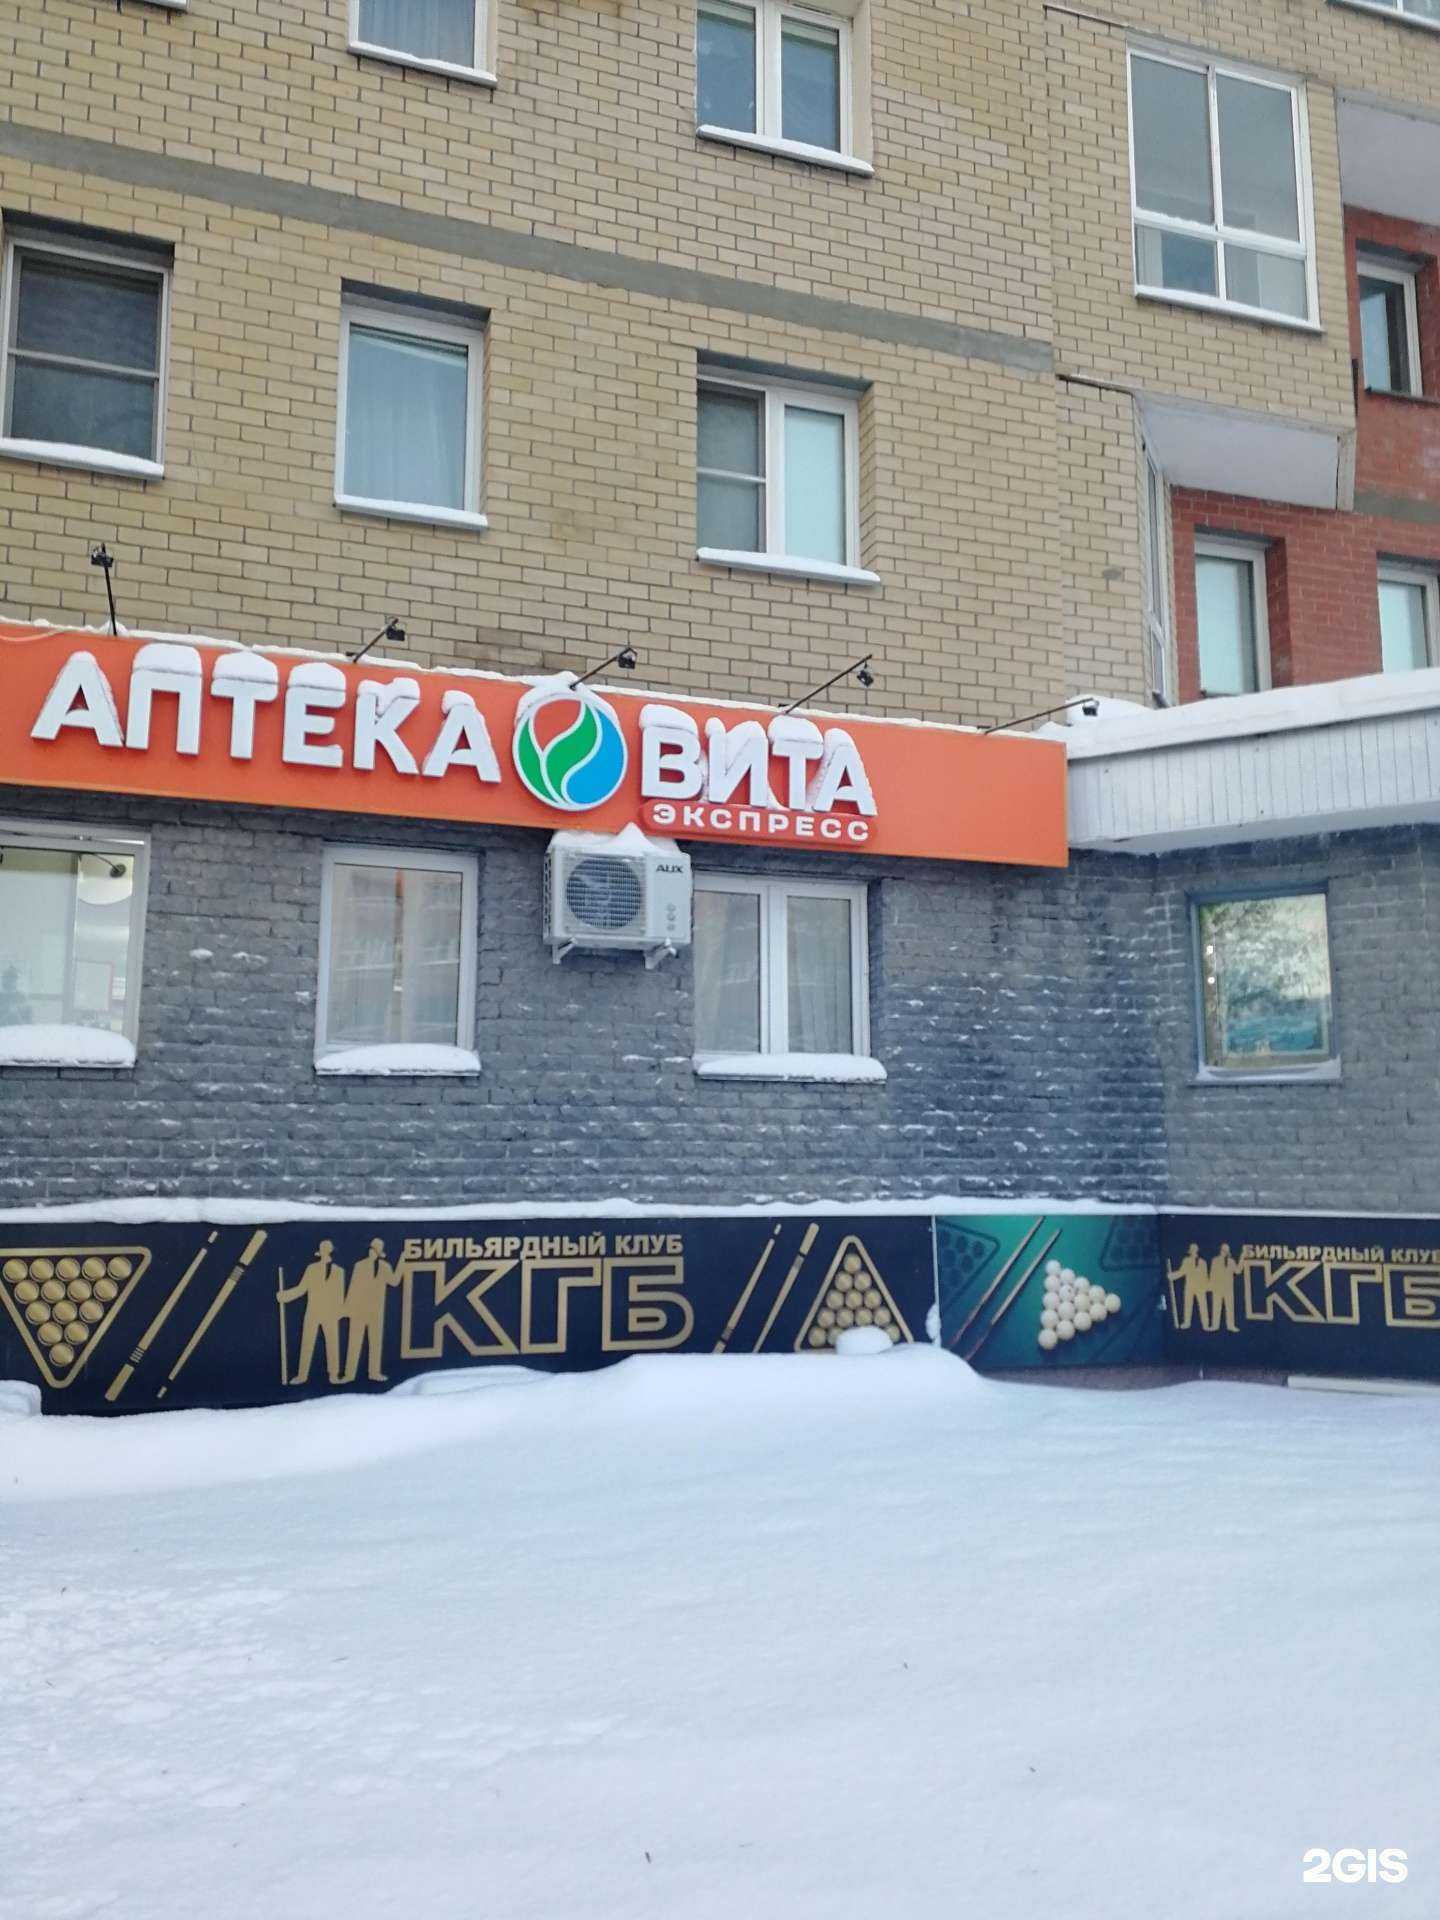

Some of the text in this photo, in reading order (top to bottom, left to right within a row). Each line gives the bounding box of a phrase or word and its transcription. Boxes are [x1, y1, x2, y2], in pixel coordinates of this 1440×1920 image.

[30, 645, 877, 816] АПТЕКА ВИТА
[653, 804, 869, 840] ЭКСПРЕСС
[656, 864, 683, 873] AUX
[404, 1232, 683, 1259] БИЛЬЯРДНЫЙ КЛУБ
[1243, 1244, 1384, 1263] БИЛЬЯРДНЫЙ
[401, 1256, 694, 1359] КГБ
[1244, 1260, 1440, 1328] КГБ
